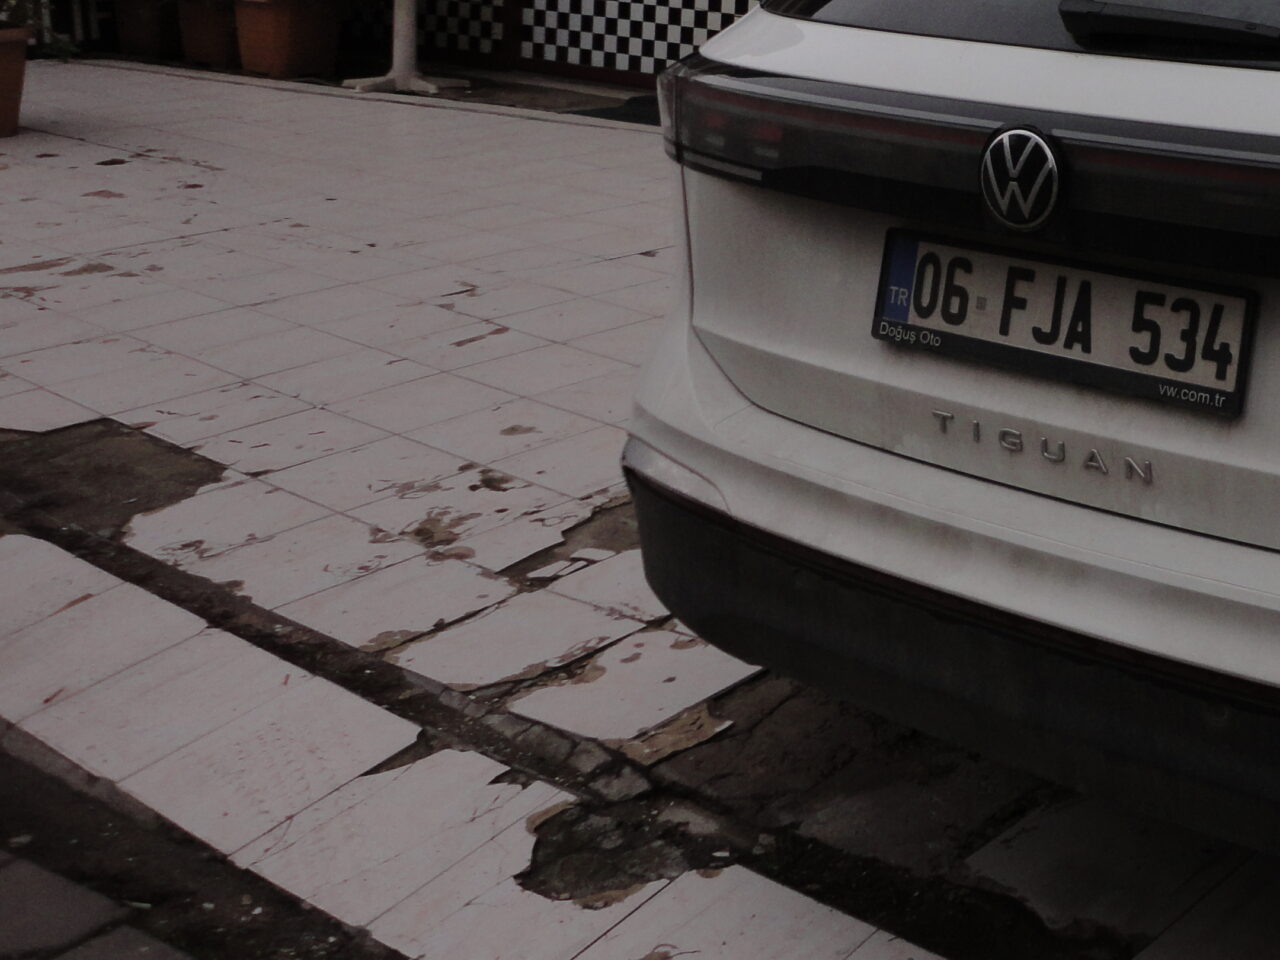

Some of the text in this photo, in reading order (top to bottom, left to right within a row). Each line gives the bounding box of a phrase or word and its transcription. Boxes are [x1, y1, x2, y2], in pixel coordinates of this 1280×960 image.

[889, 286, 909, 307] TR
[913, 251, 1234, 381] 06 FJA 534
[879, 321, 942, 348] Doğuş Oto
[1158, 383, 1226, 409] vw.com.tr
[931, 409, 1153, 484] TIGUAN
